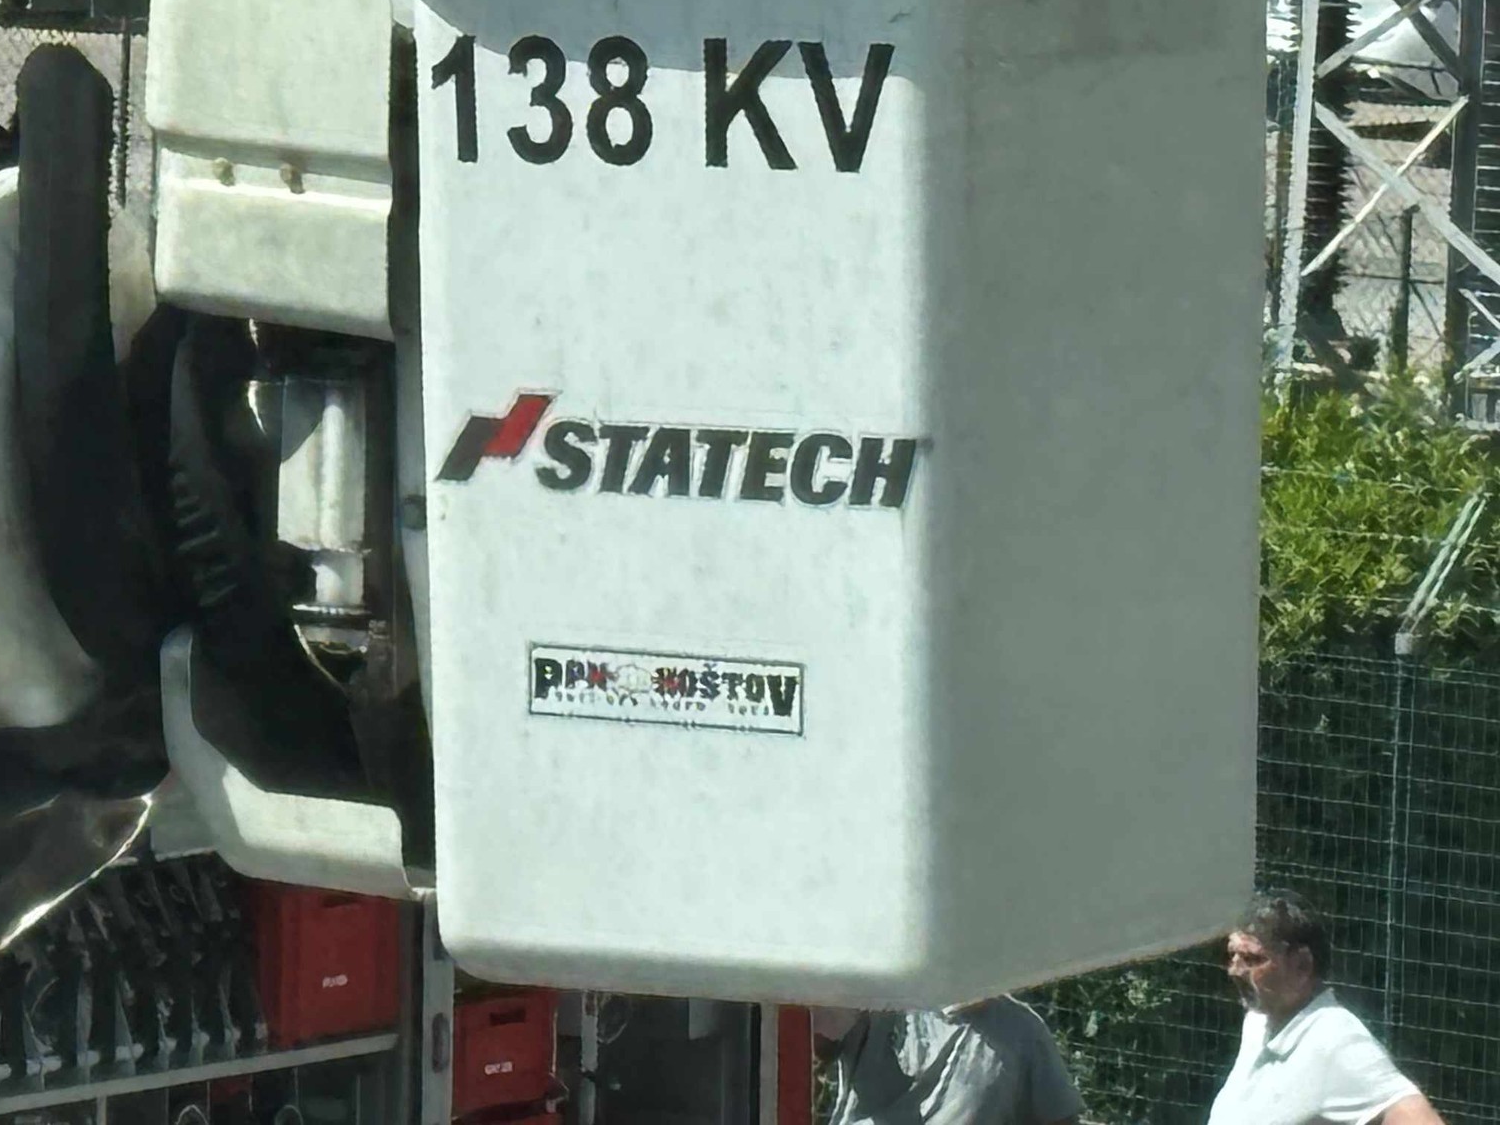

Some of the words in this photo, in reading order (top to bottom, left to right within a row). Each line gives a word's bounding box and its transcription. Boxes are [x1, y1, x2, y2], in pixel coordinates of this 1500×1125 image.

[431, 34, 653, 166] 138
[703, 37, 895, 173] KV
[534, 417, 917, 509] STATECH
